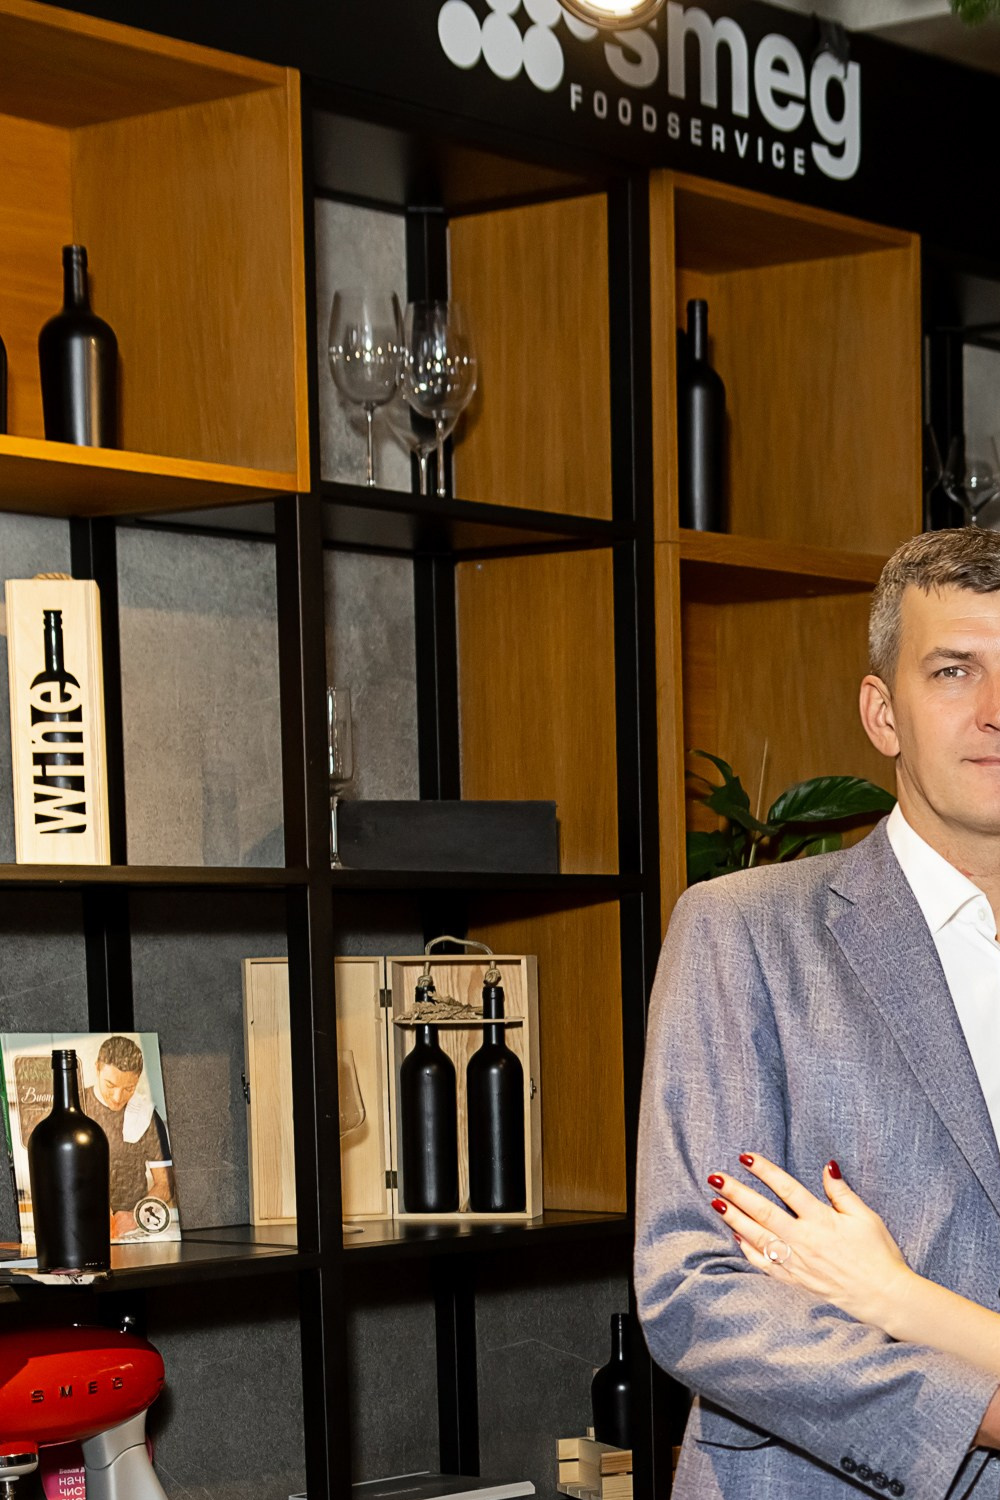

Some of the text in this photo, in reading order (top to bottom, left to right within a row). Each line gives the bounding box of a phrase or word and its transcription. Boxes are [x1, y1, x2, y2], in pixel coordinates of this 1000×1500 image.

[570, 83, 807, 176] FOODSERVICE
[604, 1, 861, 181] smeg
[30, 1377, 124, 1403] SMEG
